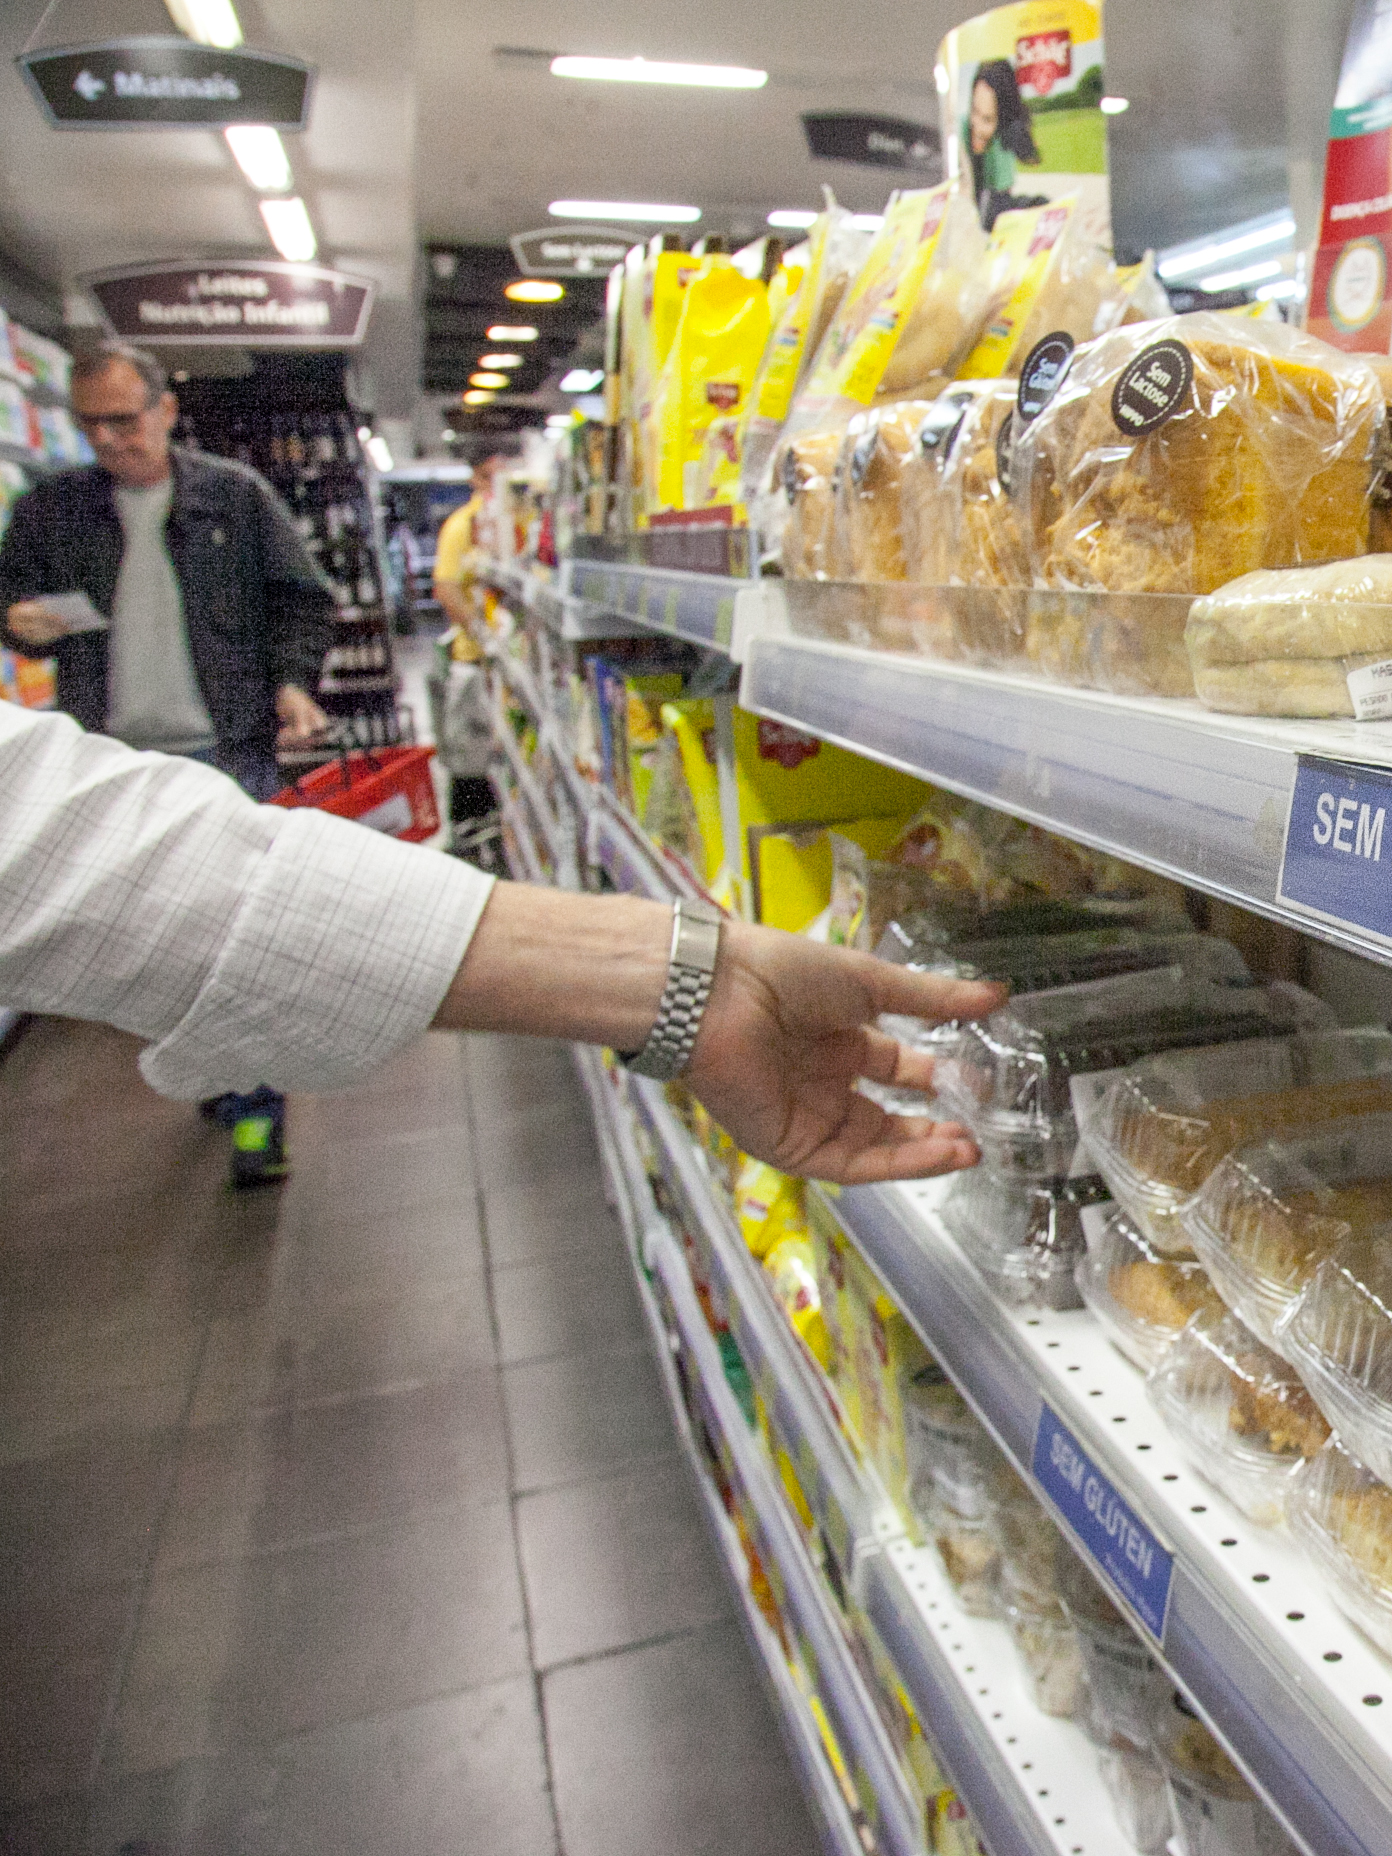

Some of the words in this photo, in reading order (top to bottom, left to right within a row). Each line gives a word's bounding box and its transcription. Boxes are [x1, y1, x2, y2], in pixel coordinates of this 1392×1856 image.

[243, 300, 330, 325] Infantil
[1128, 371, 1169, 407] Lactose
[1146, 361, 1172, 387] Sem
[1312, 791, 1386, 862] SEM
[1050, 1432, 1085, 1493] SEM
